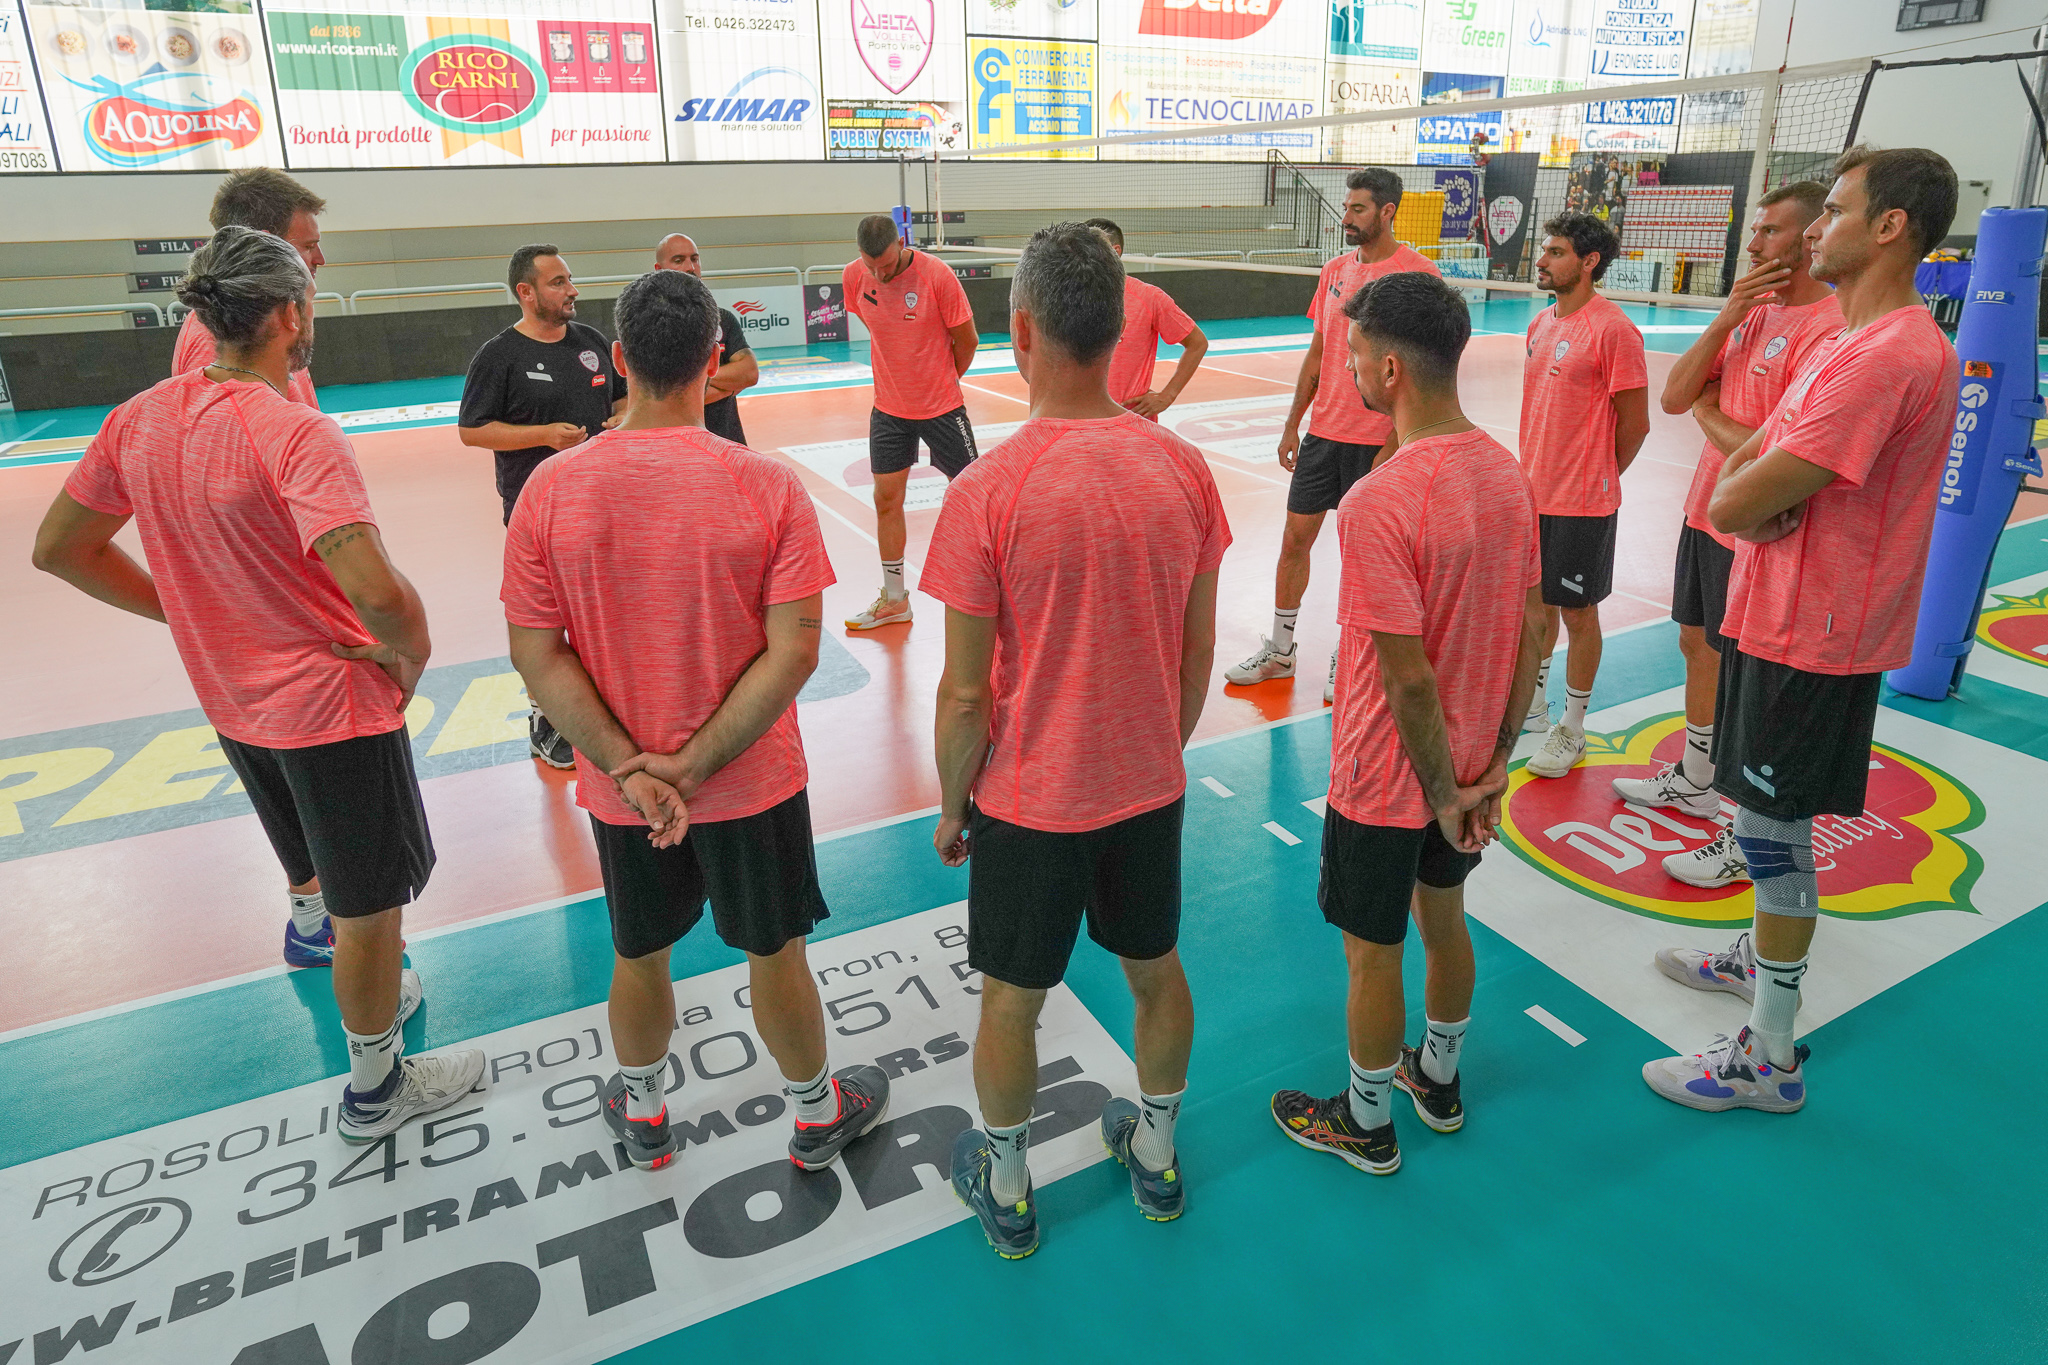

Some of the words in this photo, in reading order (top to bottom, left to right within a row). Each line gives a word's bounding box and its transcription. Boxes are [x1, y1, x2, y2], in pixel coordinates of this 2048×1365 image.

[685, 16, 710, 29] Tel.
[714, 17, 796, 32] 0426.322473
[1606, 12, 1673, 28] CONSULENZA
[309, 25, 331, 38] dal
[332, 25, 362, 39] 1936
[873, 31, 914, 41] VOLLEY
[1573, 27, 1588, 38] LNG
[1595, 29, 1684, 46] AUTOMOBILISTICA
[276, 40, 398, 58] www.ricocarni.it
[868, 41, 899, 51] PORTO
[900, 42, 921, 52] VIRO
[437, 52, 509, 70] RICO
[1014, 48, 1092, 68] COMMERCIALE
[1186, 56, 1244, 69] Riscaldamento
[1611, 52, 1654, 70] VERONESE
[1655, 53, 1680, 69] LUIGI
[429, 71, 520, 90] CARNI
[1019, 69, 1088, 87] FERRAMENTA
[1509, 77, 1548, 94] BELTRAME
[1015, 90, 1063, 105] COMMERCIO
[1329, 79, 1412, 106] LOSTARIA
[674, 97, 811, 122] SLIMAR
[1145, 97, 1314, 123] TECNOCLIMAP
[1603, 100, 1673, 124] 0426.321078
[100, 106, 256, 146] AQUOLINA
[721, 124, 758, 132] marine
[761, 122, 802, 132] solution
[1435, 120, 1501, 142] PATIO
[289, 124, 351, 146] Bontà
[355, 125, 433, 150] prodotte
[551, 126, 578, 147] per
[582, 124, 653, 147] passione
[830, 129, 881, 148] PUBBLY
[884, 130, 931, 148] SYSTEM
[0, 152, 47, 169] 97083
[159, 241, 191, 252] FILA
[161, 276, 179, 287] FI
[1976, 290, 2006, 300] FIVB
[1940, 411, 1978, 506] Senoh
[1446, 1034, 1458, 1054] nine
